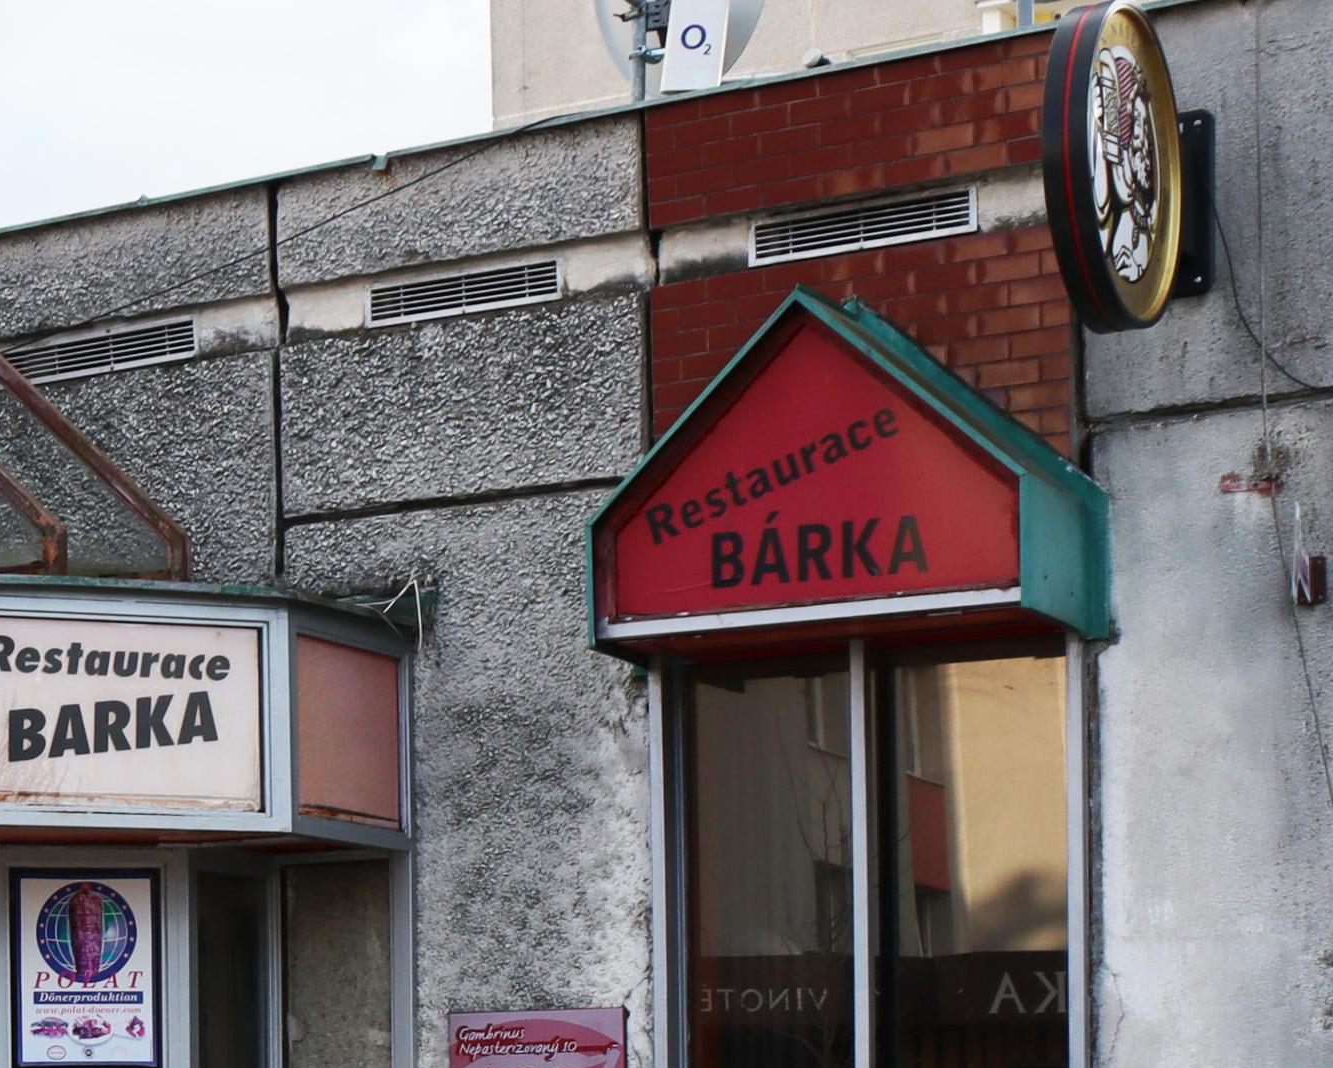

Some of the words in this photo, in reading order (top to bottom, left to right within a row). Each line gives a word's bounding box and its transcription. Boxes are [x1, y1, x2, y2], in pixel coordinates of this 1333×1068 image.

[645, 407, 899, 545] Restaurace
[711, 511, 929, 589] BÁRKA
[8, 690, 219, 762] BARKA
[33, 970, 144, 989] POLAT
[39, 992, 138, 1003] Dönerproduktion
[35, 1005, 142, 1014] www.polat-doener.com
[459, 1025, 525, 1041] Gambrinus
[459, 1040, 559, 1060] Nepasterizovaný
[562, 1041, 578, 1052] 10
